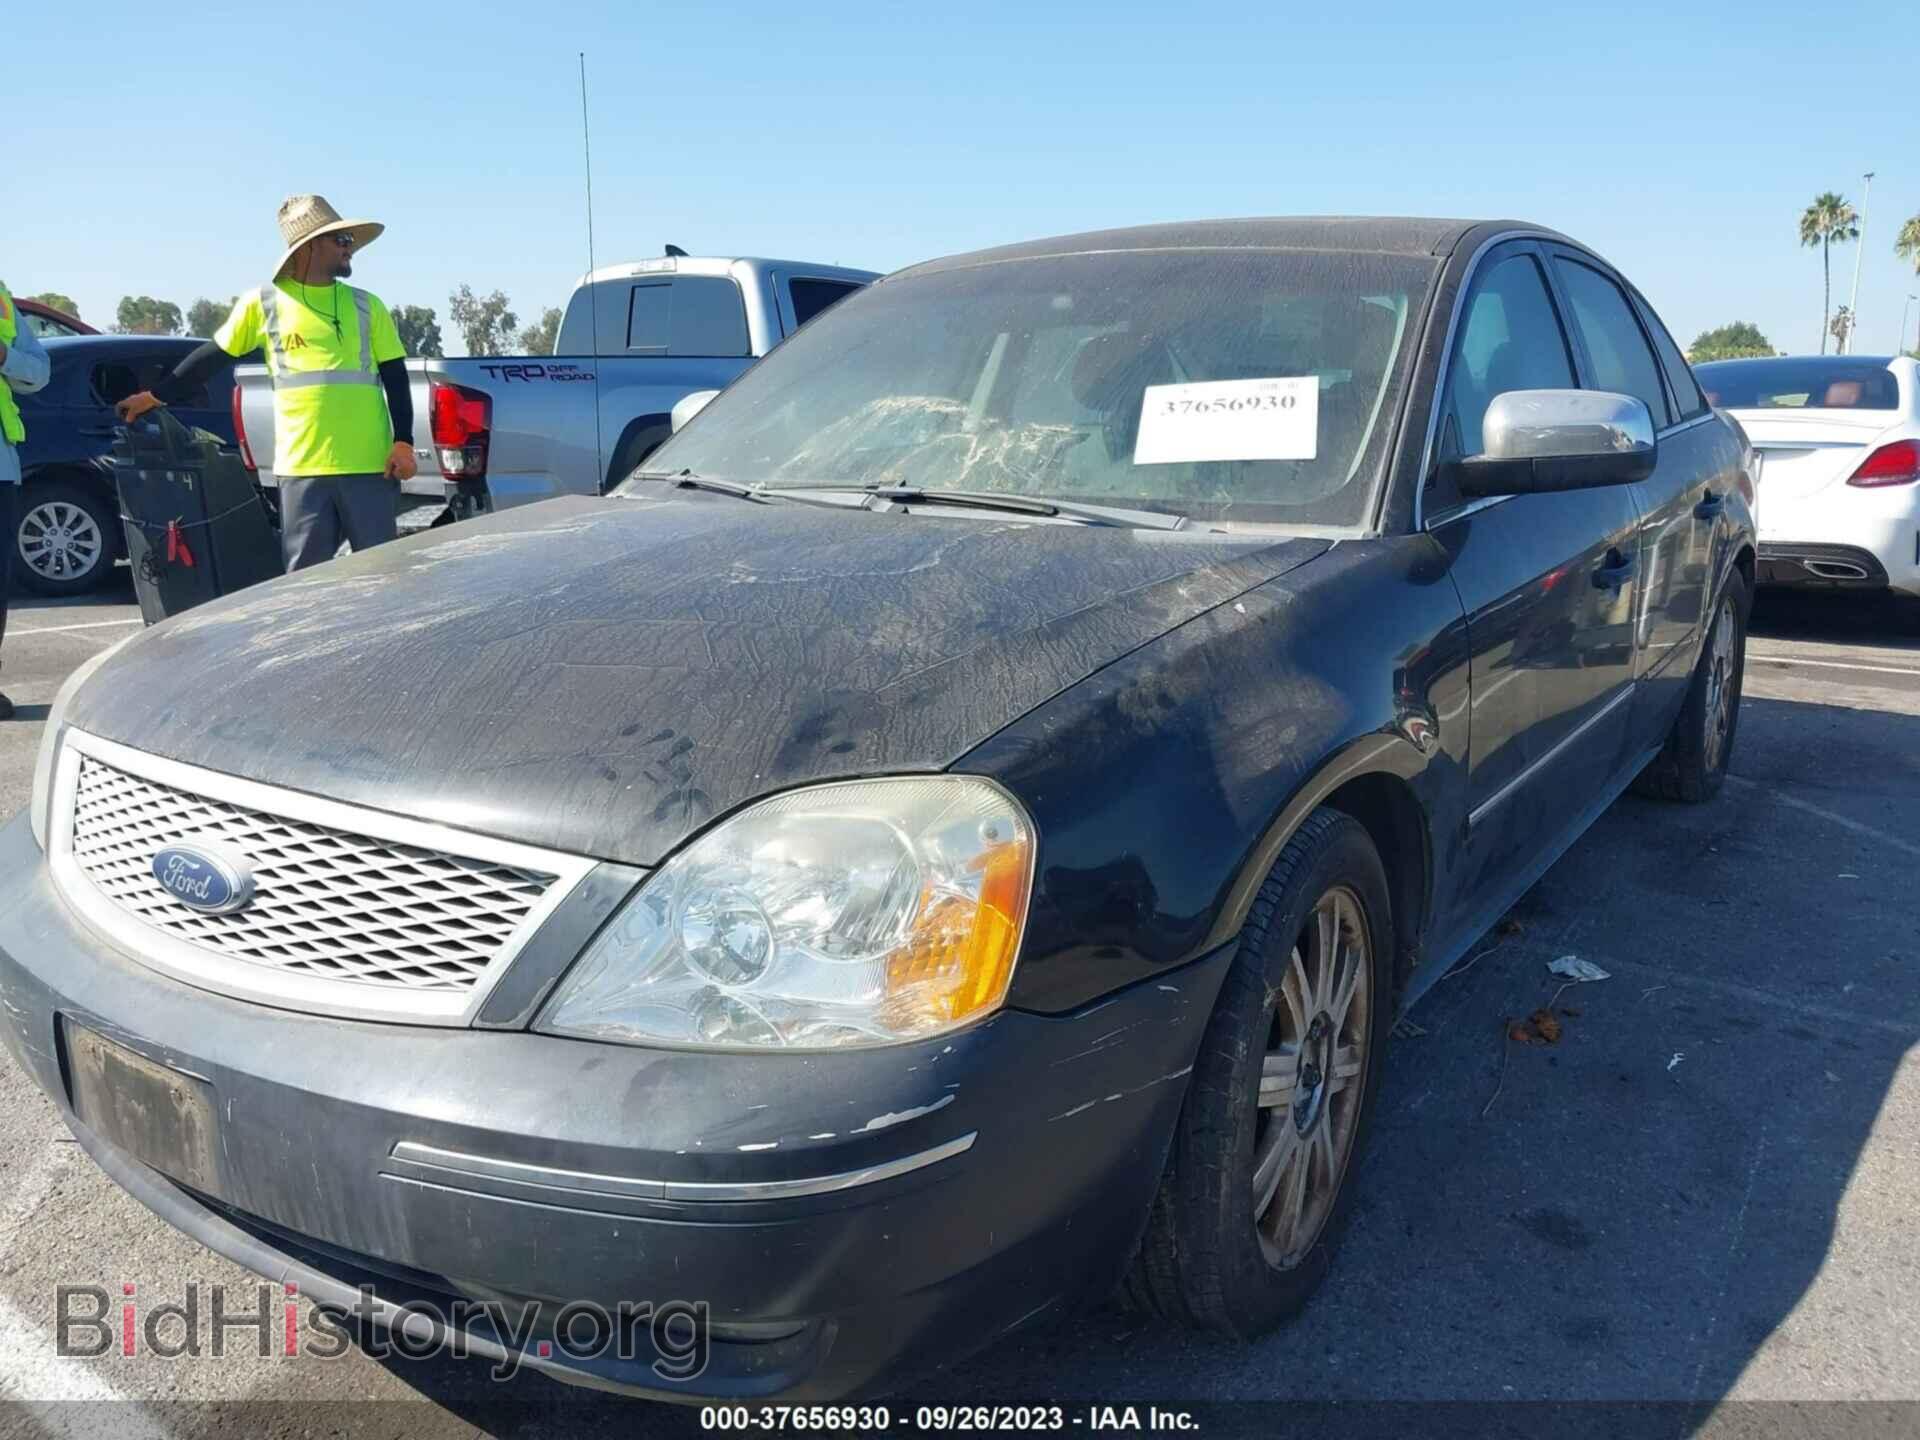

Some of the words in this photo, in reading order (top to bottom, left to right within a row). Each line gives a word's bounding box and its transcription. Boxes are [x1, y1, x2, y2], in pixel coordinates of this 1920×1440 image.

[479, 364, 545, 383] TRD
[546, 364, 579, 372] OFF
[550, 373, 596, 381] ROAD
[1160, 394, 1297, 416] 37656930
[162, 855, 213, 900] Ford
